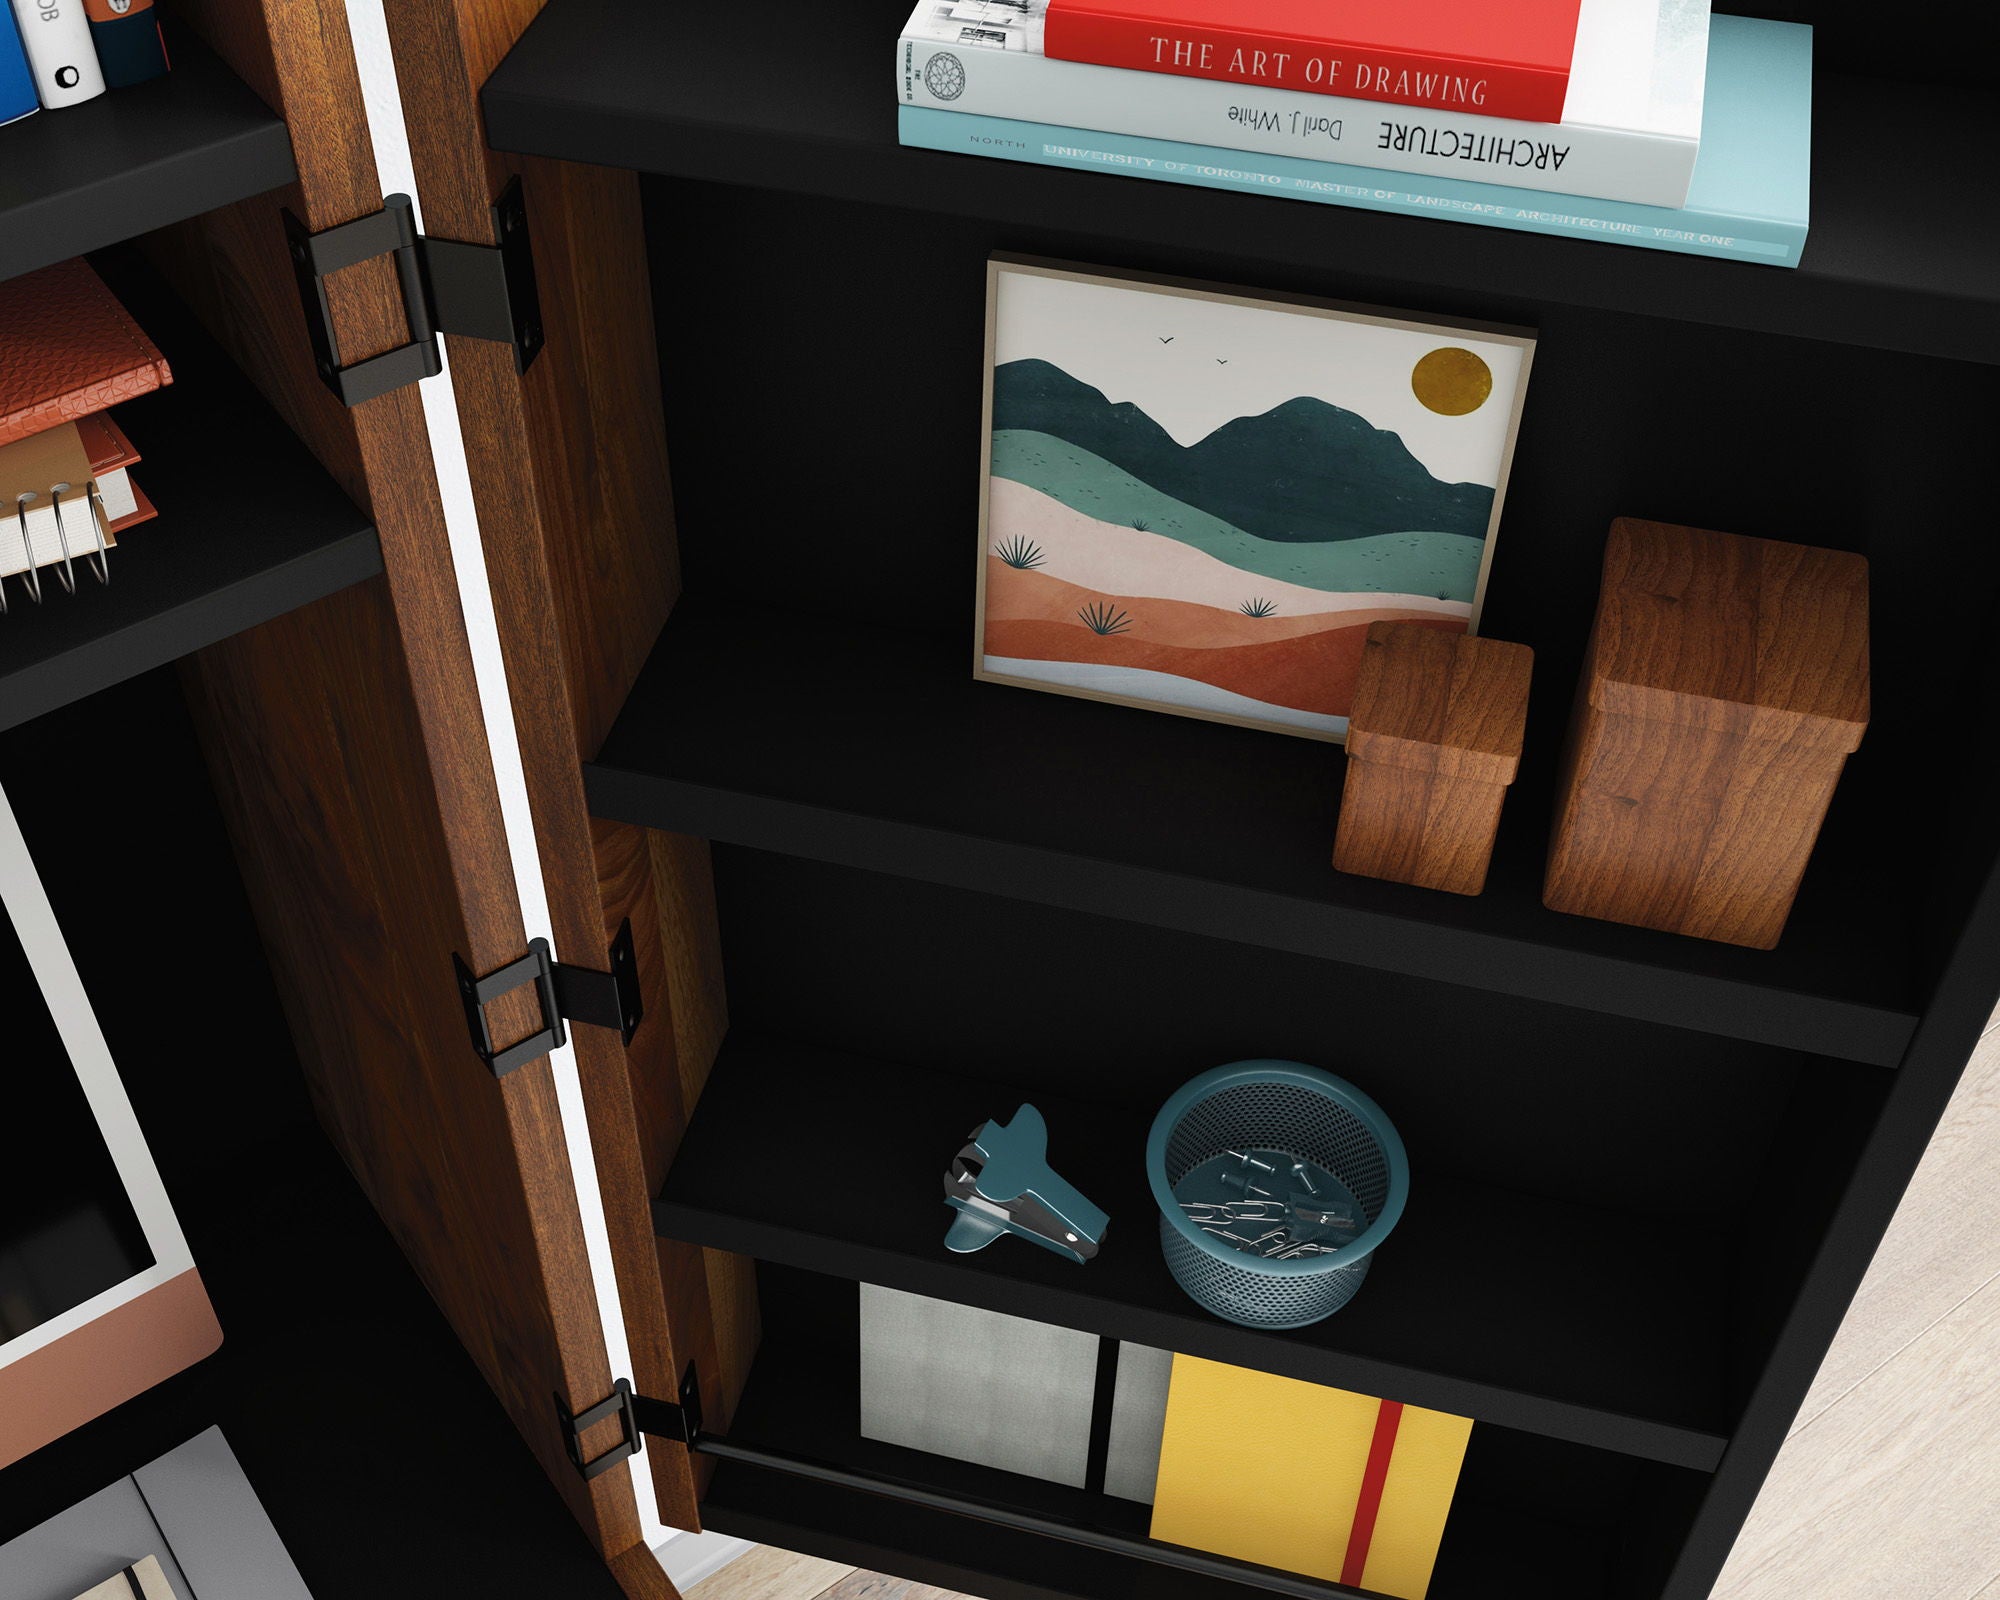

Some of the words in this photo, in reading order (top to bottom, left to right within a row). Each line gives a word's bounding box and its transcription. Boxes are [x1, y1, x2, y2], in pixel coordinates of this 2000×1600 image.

[1150, 36, 1214, 70] THE
[1228, 48, 1291, 79] ART
[1305, 57, 1342, 86] OF
[1355, 65, 1487, 105] DRAWING
[1228, 106, 1281, 132] White
[1288, 111, 1302, 134] J.
[1303, 118, 1343, 141] Daril
[969, 135, 1027, 149] NORTH
[1377, 121, 1571, 171] ARCHITECTURE
[1042, 144, 1156, 167] UNIVERSITY
[1164, 161, 1189, 172] OF
[1195, 165, 1281, 185] TORONTO
[1296, 179, 1369, 197] MASTER
[1374, 190, 1398, 200] OF
[1406, 195, 1505, 215] LANDSCAPE
[1516, 209, 1643, 235] ARCHITECTURE
[1652, 227, 1696, 242] YEAR
[1698, 234, 1736, 248] ONE
